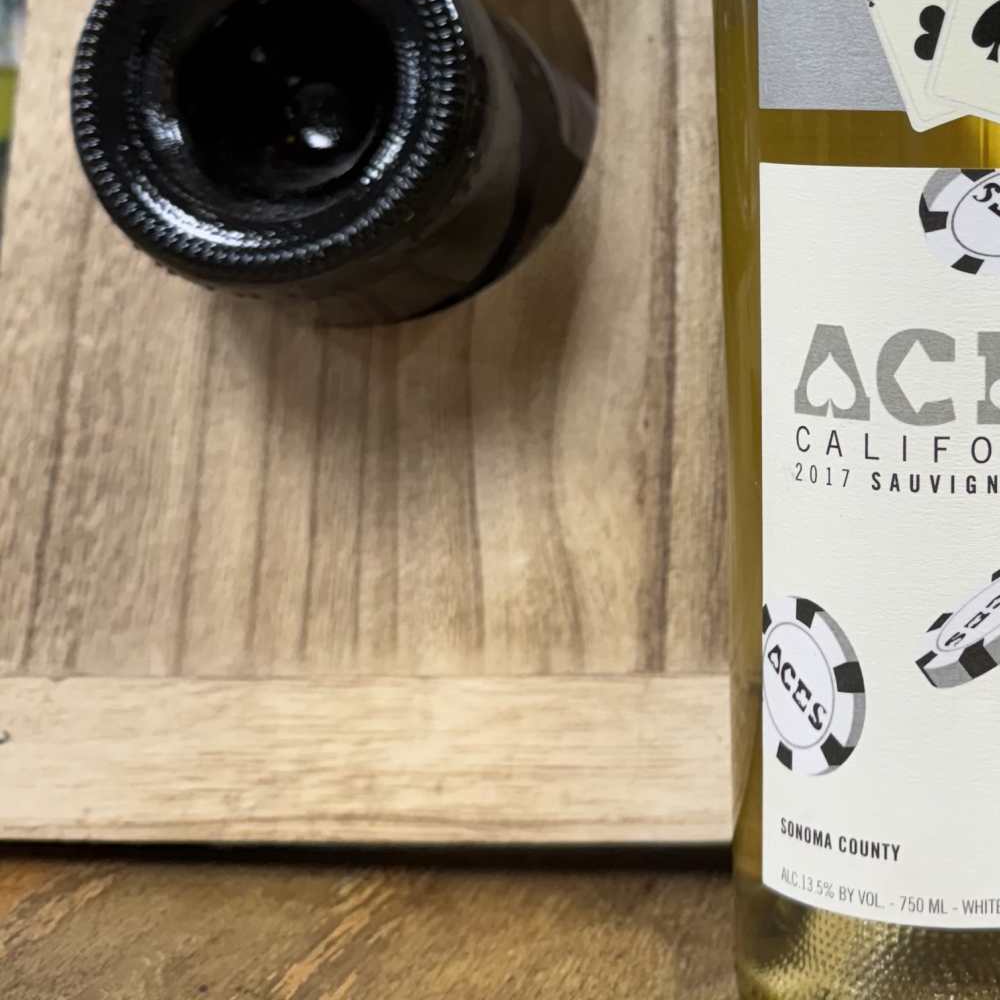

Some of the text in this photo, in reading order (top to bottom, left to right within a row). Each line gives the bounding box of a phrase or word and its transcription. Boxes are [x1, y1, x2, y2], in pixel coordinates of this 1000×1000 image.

[794, 461, 851, 488] 2017
[766, 644, 828, 731] ACES
[780, 817, 901, 862] SONOMA COUNTY
[839, 886, 855, 903] BY
[900, 895, 924, 914] 750
[928, 897, 948, 915] ML
